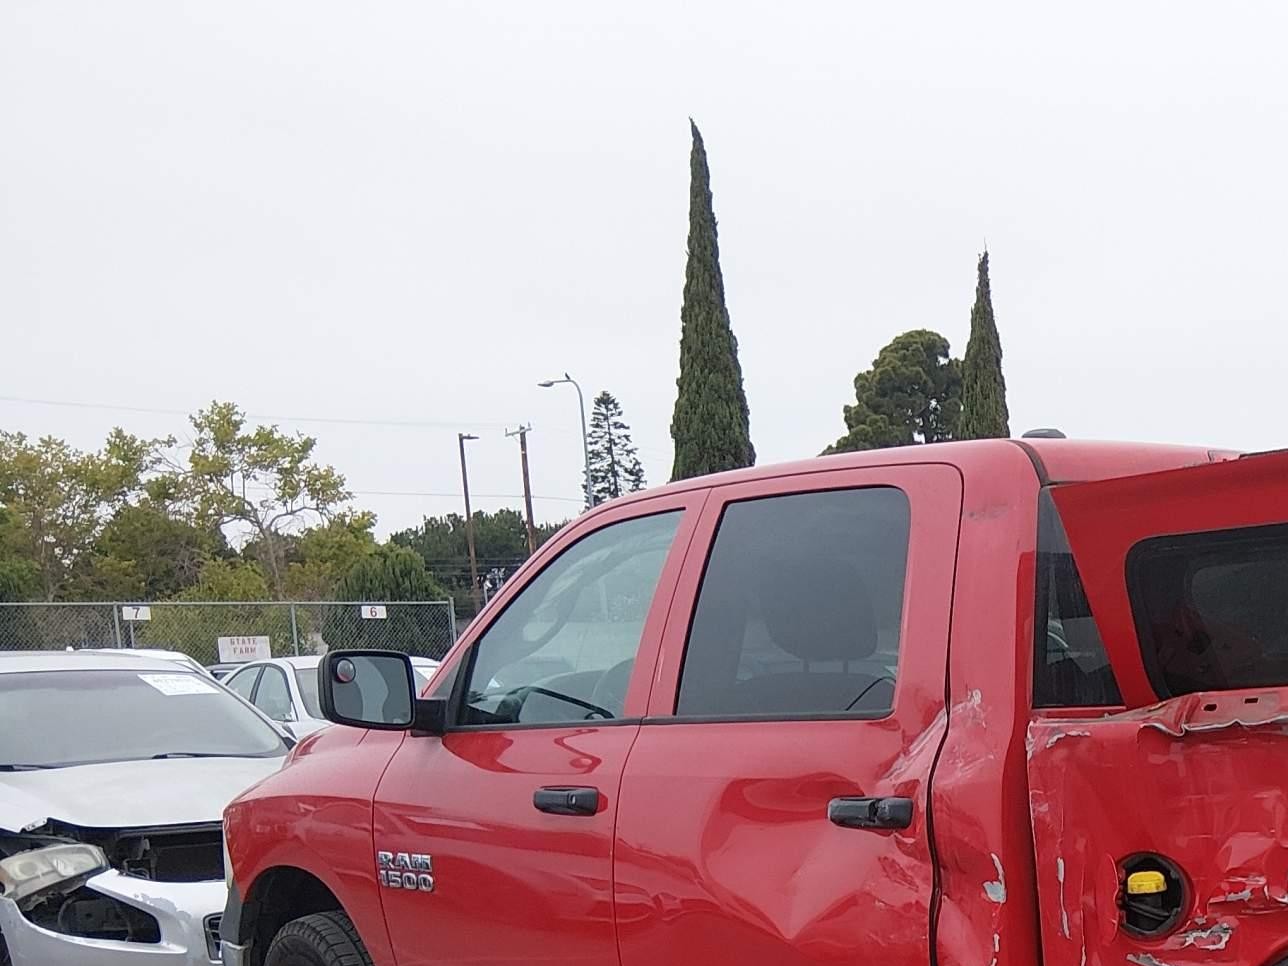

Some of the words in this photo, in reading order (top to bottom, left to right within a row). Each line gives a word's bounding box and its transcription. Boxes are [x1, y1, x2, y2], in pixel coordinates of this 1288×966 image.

[132, 607, 141, 619] 7
[370, 606, 378, 618] 6
[378, 850, 432, 872] RAM
[379, 869, 434, 893] 1500
